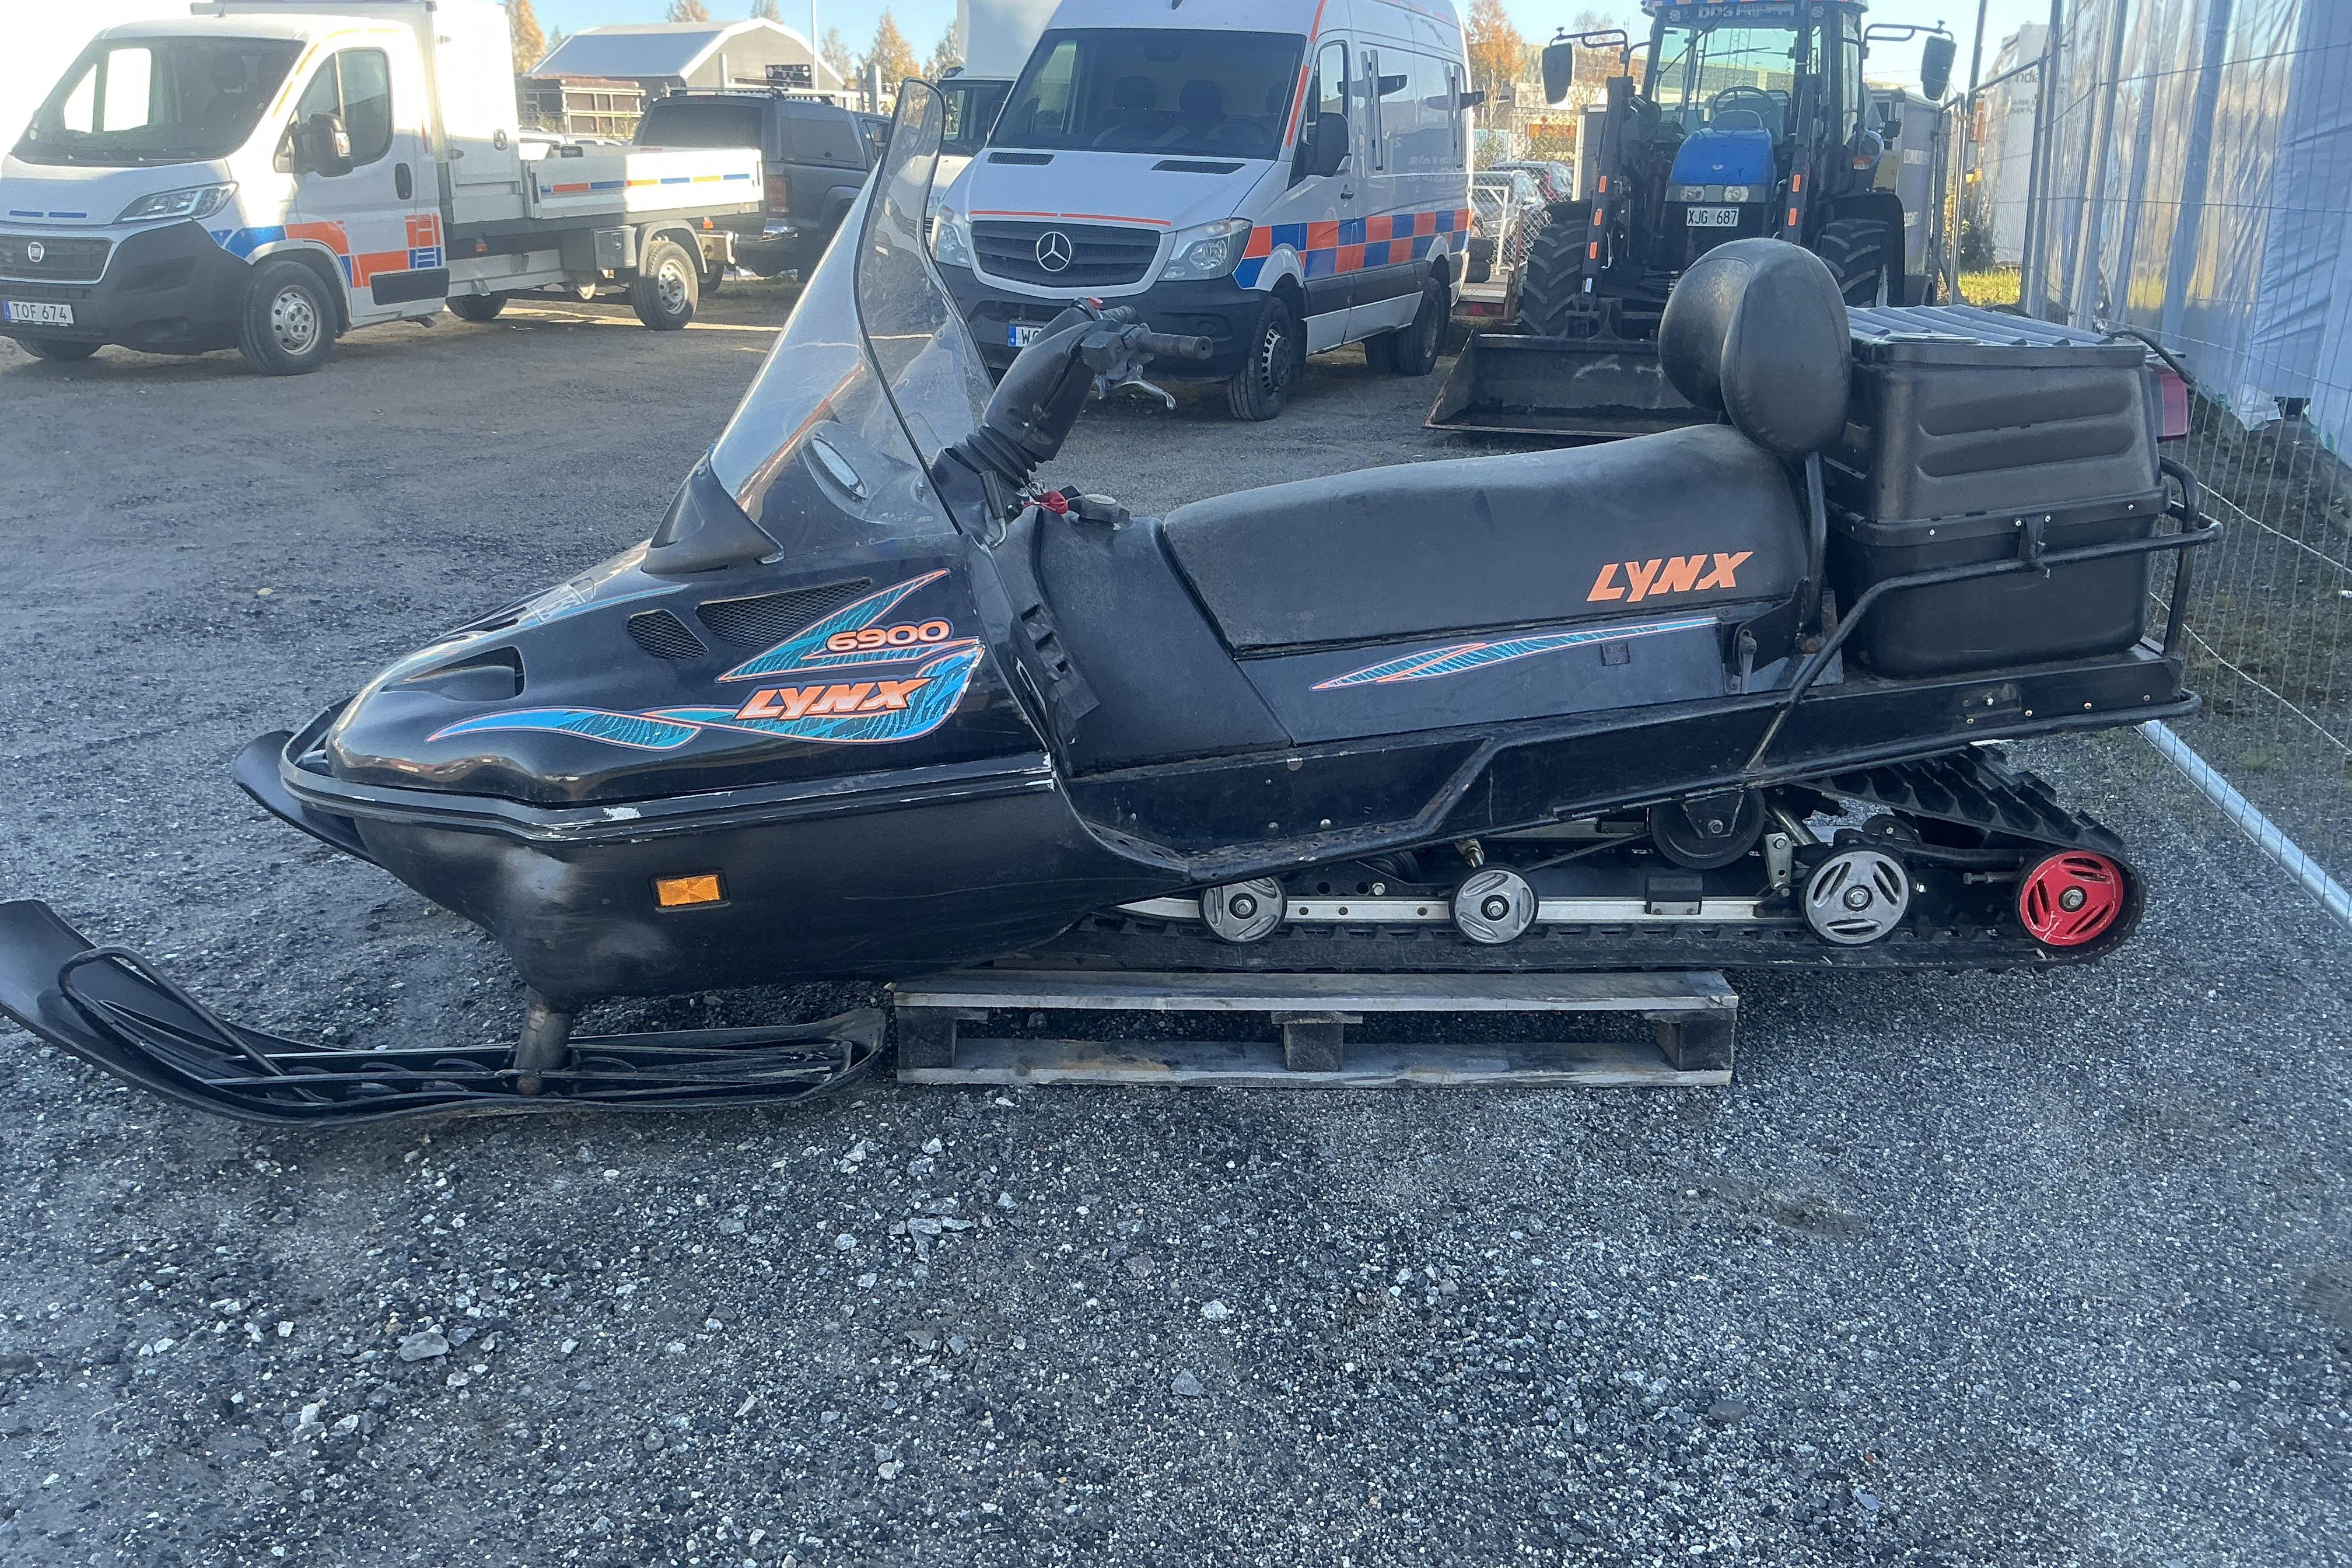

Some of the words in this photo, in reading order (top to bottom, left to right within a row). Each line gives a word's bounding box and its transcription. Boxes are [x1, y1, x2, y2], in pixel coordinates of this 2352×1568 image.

[1688, 210, 1709, 225] XJG
[1716, 211, 1738, 225] 687
[12, 303, 36, 319] TOF
[42, 305, 68, 321] 674
[1586, 551, 1754, 603] LYNX
[825, 620, 951, 652] 6900
[735, 677, 934, 720] LYNX
